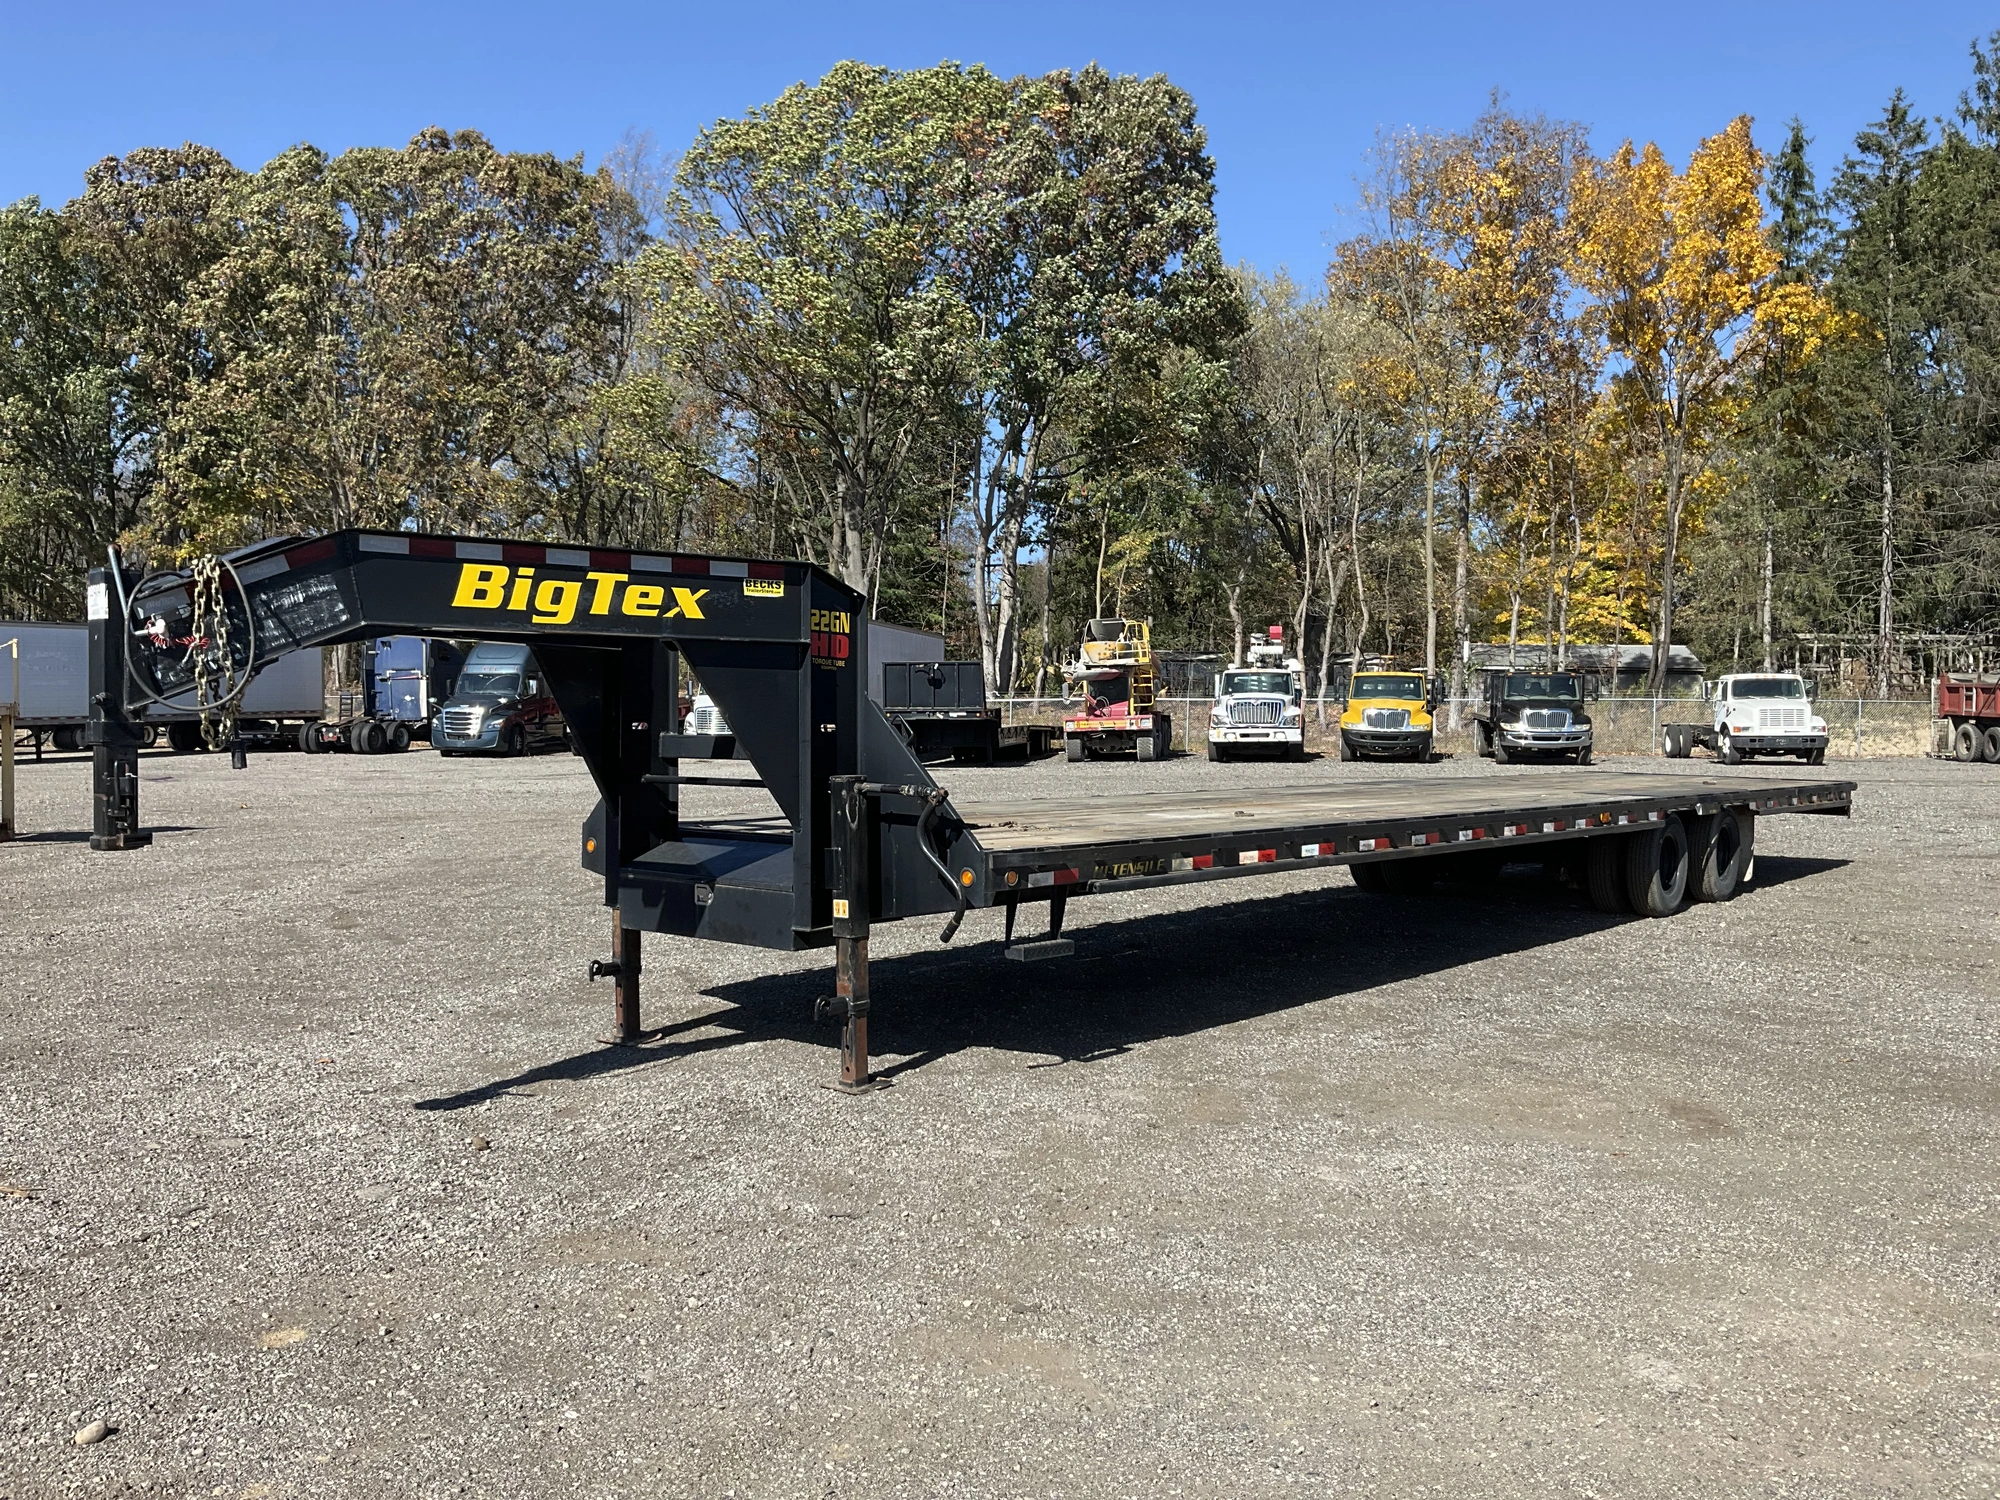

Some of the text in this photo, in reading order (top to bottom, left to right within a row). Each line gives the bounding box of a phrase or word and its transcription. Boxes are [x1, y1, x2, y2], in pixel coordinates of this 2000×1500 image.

[451, 563, 710, 625] BigTex
[745, 579, 781, 589] BECKS
[811, 609, 850, 633] 22GN
[811, 632, 849, 659] HD
